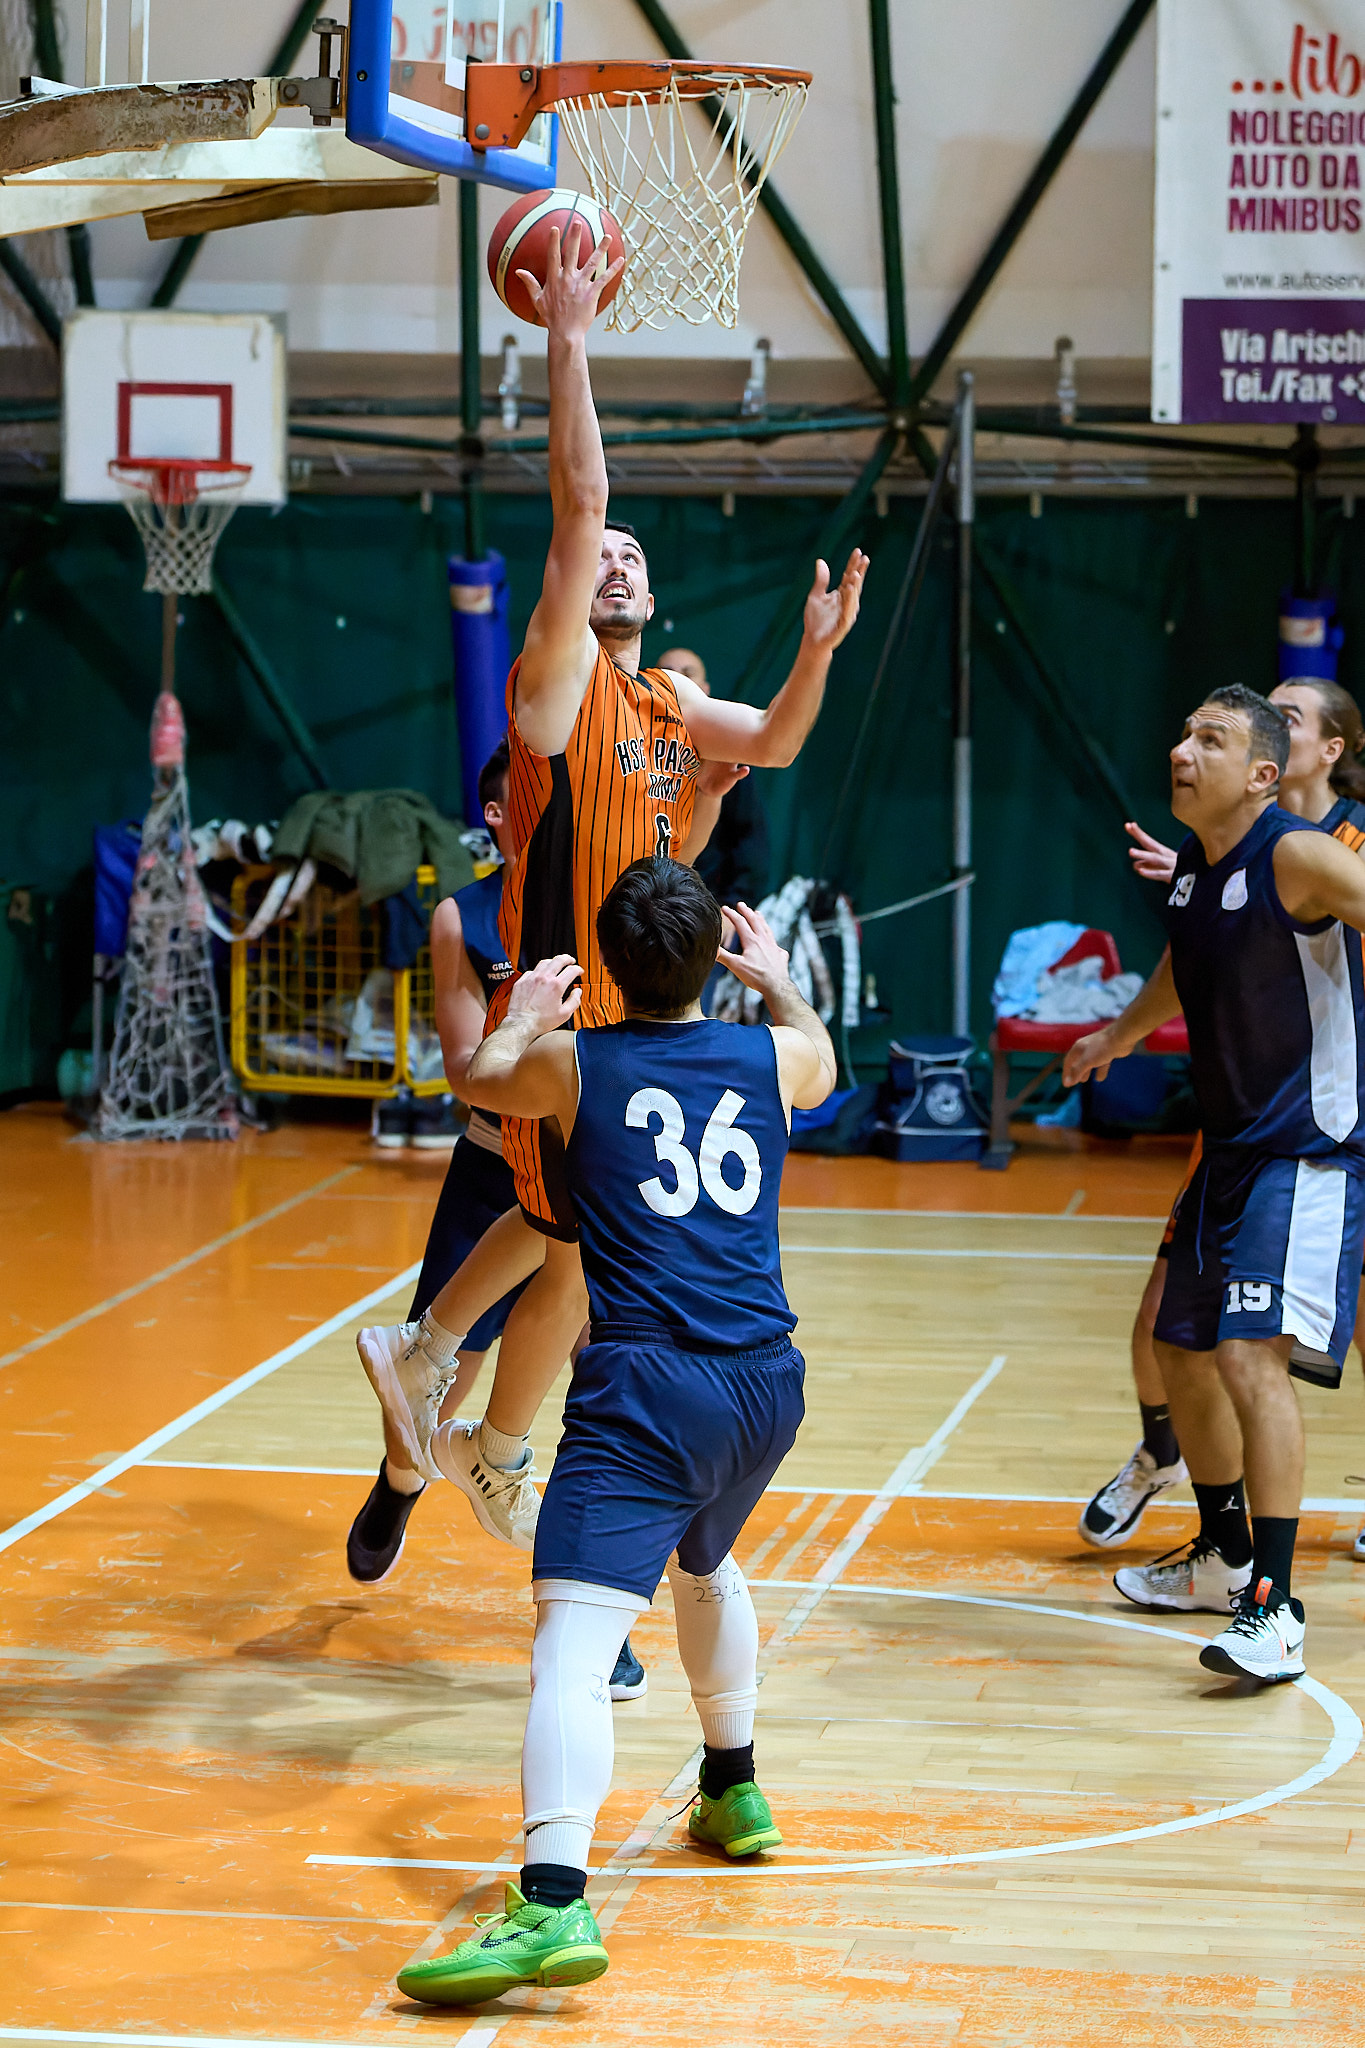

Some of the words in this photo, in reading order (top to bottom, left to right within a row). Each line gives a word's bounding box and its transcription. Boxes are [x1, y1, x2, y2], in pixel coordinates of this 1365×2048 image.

[1230, 23, 1365, 101] ...lib
[1229, 154, 1309, 189] AUTO
[1321, 154, 1359, 189] DA
[1228, 198, 1361, 232] MINIBUS
[1220, 328, 1266, 363] Via
[1271, 328, 1365, 364] Arisch
[625, 1087, 763, 1218] 36
[1226, 1281, 1272, 1314] 19
